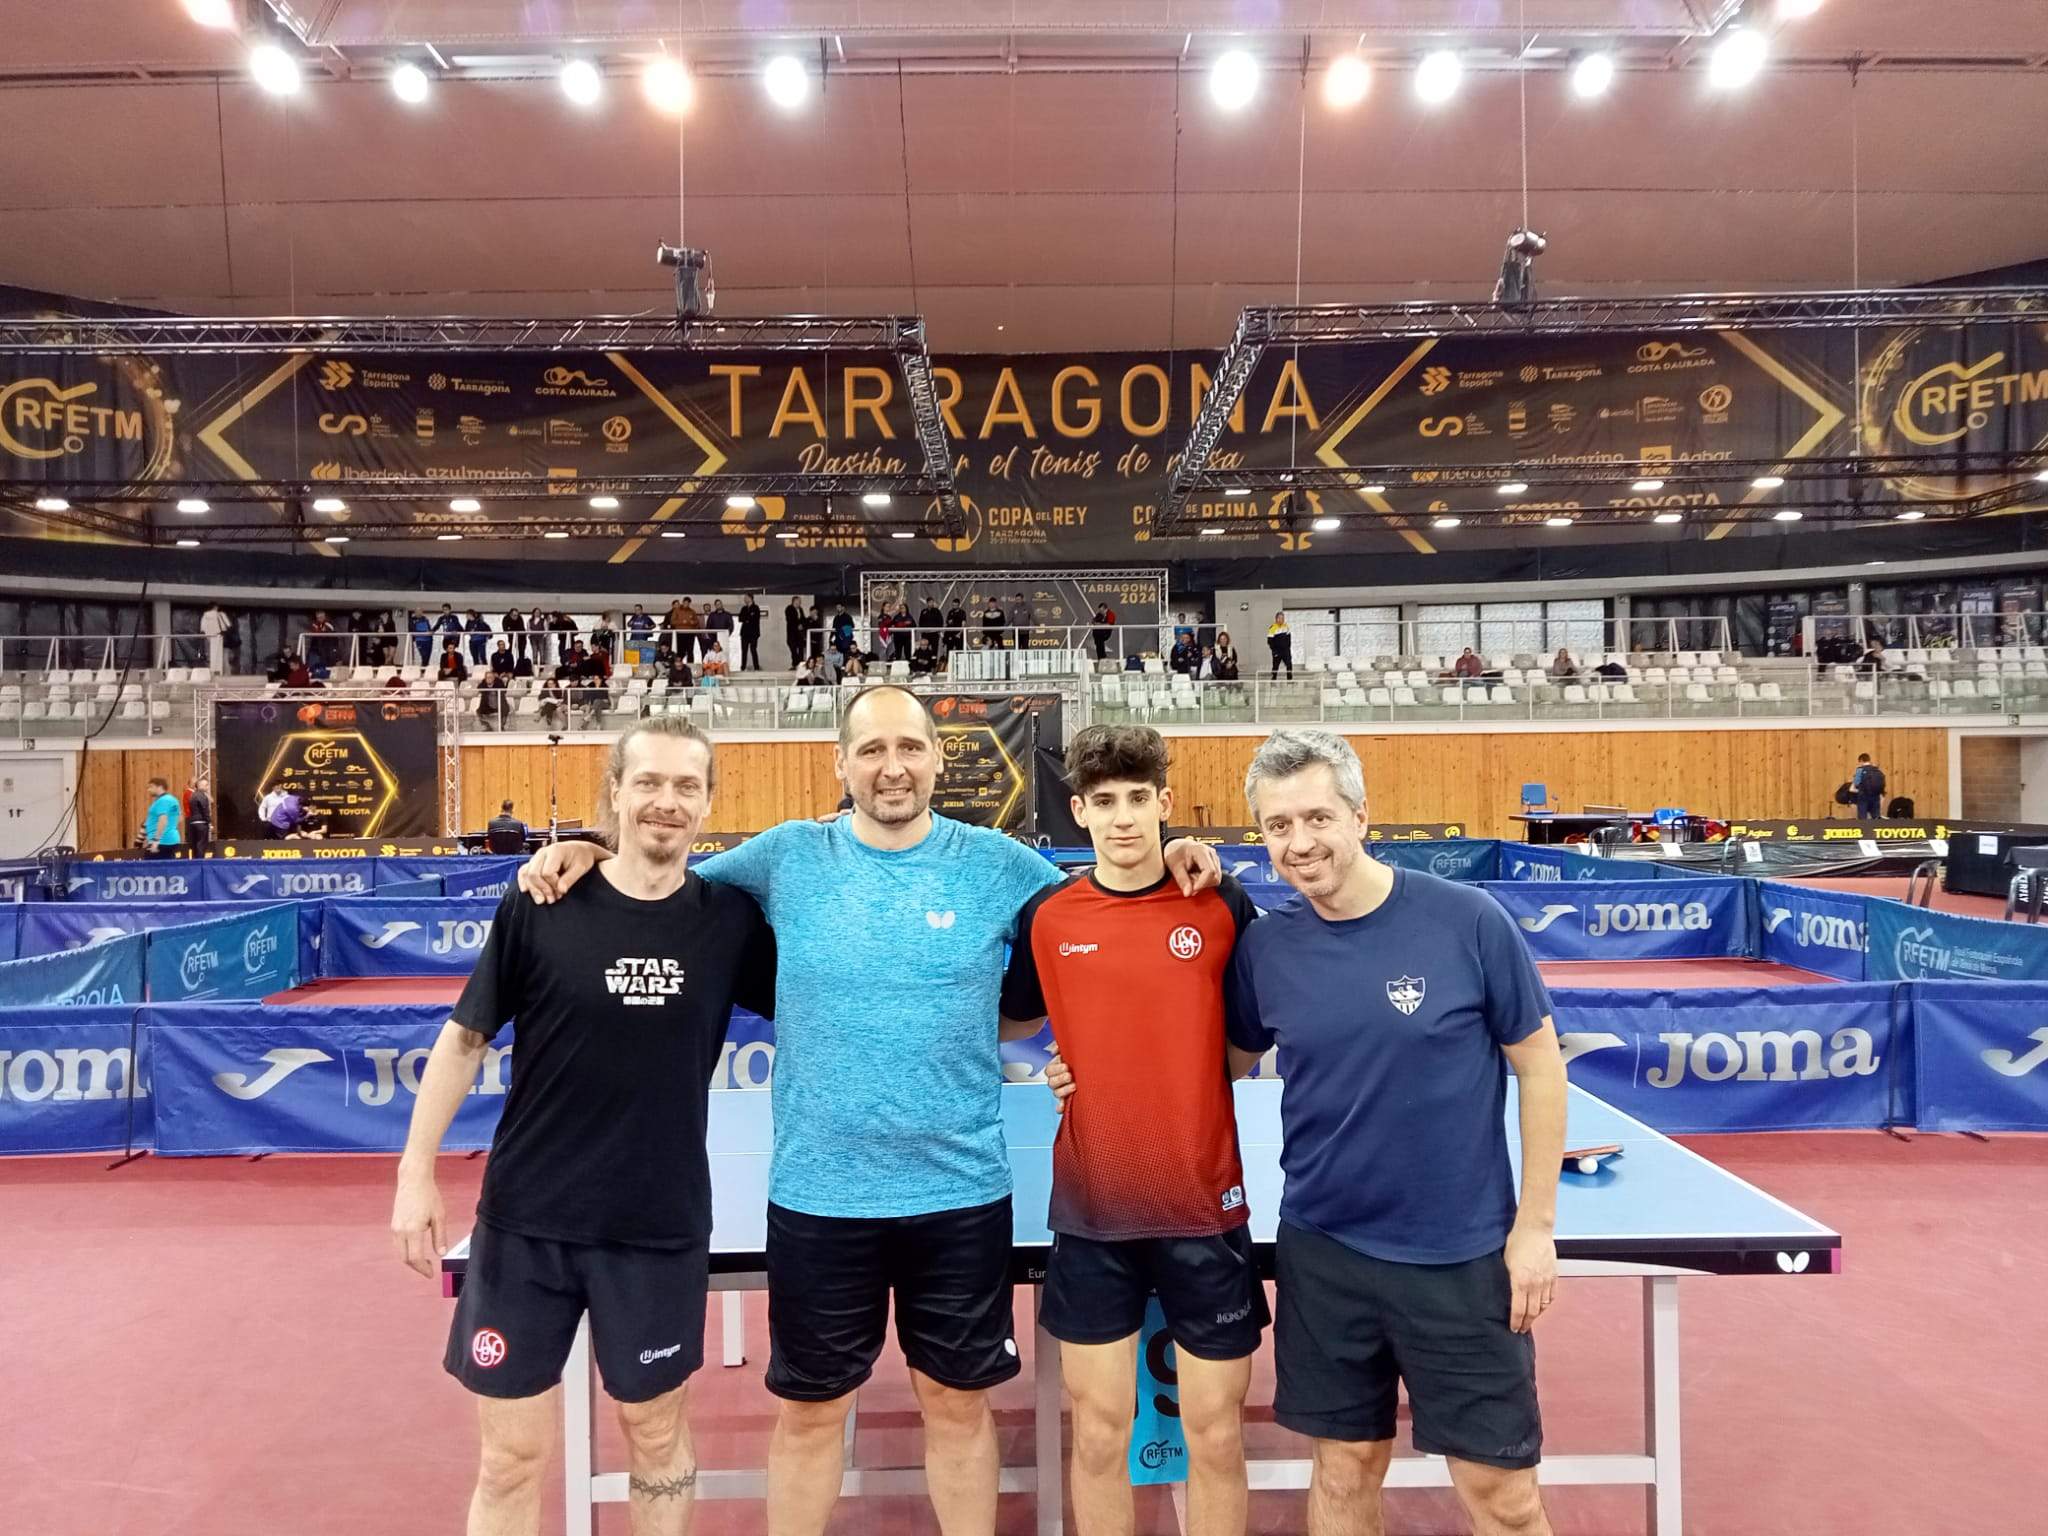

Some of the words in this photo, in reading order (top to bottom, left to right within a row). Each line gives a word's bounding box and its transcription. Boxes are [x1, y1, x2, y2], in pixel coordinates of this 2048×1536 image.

[1627, 363, 1662, 374] COSTA
[1663, 358, 1716, 370] DAURADA
[362, 370, 410, 382] Tarragona
[363, 380, 400, 389] Esports
[535, 386, 567, 396] COSTA
[569, 387, 617, 397] DAURADA
[710, 360, 1321, 439] TARRAGONA
[1922, 371, 2048, 416] RFETM
[15, 396, 143, 440] RFETM
[798, 442, 907, 475] Pasión
[989, 445, 1020, 480] el
[1030, 445, 1103, 479] tenis
[1117, 443, 1152, 478] de
[988, 507, 1034, 527] COPA
[1036, 511, 1052, 521] DEL
[1053, 506, 1088, 526] REY
[1081, 583, 1156, 593] TARRAGONA
[1119, 592, 1156, 604] 2024
[311, 748, 348, 759] RFETM
[946, 741, 980, 752] RFETM
[971, 800, 1000, 808] TOYOTA
[1873, 827, 1927, 839] TOYOTA
[313, 848, 367, 858] TOYOTA
[1436, 857, 1472, 869] RFETM
[101, 874, 189, 900] Joma
[277, 871, 365, 897] Joma
[1589, 901, 1713, 937] Joma
[186, 952, 219, 973] RFETM
[1903, 940, 1951, 971] RFETM
[604, 957, 685, 976] STAR
[604, 976, 685, 995] WARS
[1646, 1027, 1880, 1089] Joma
[1146, 1446, 1184, 1460] RFETM
